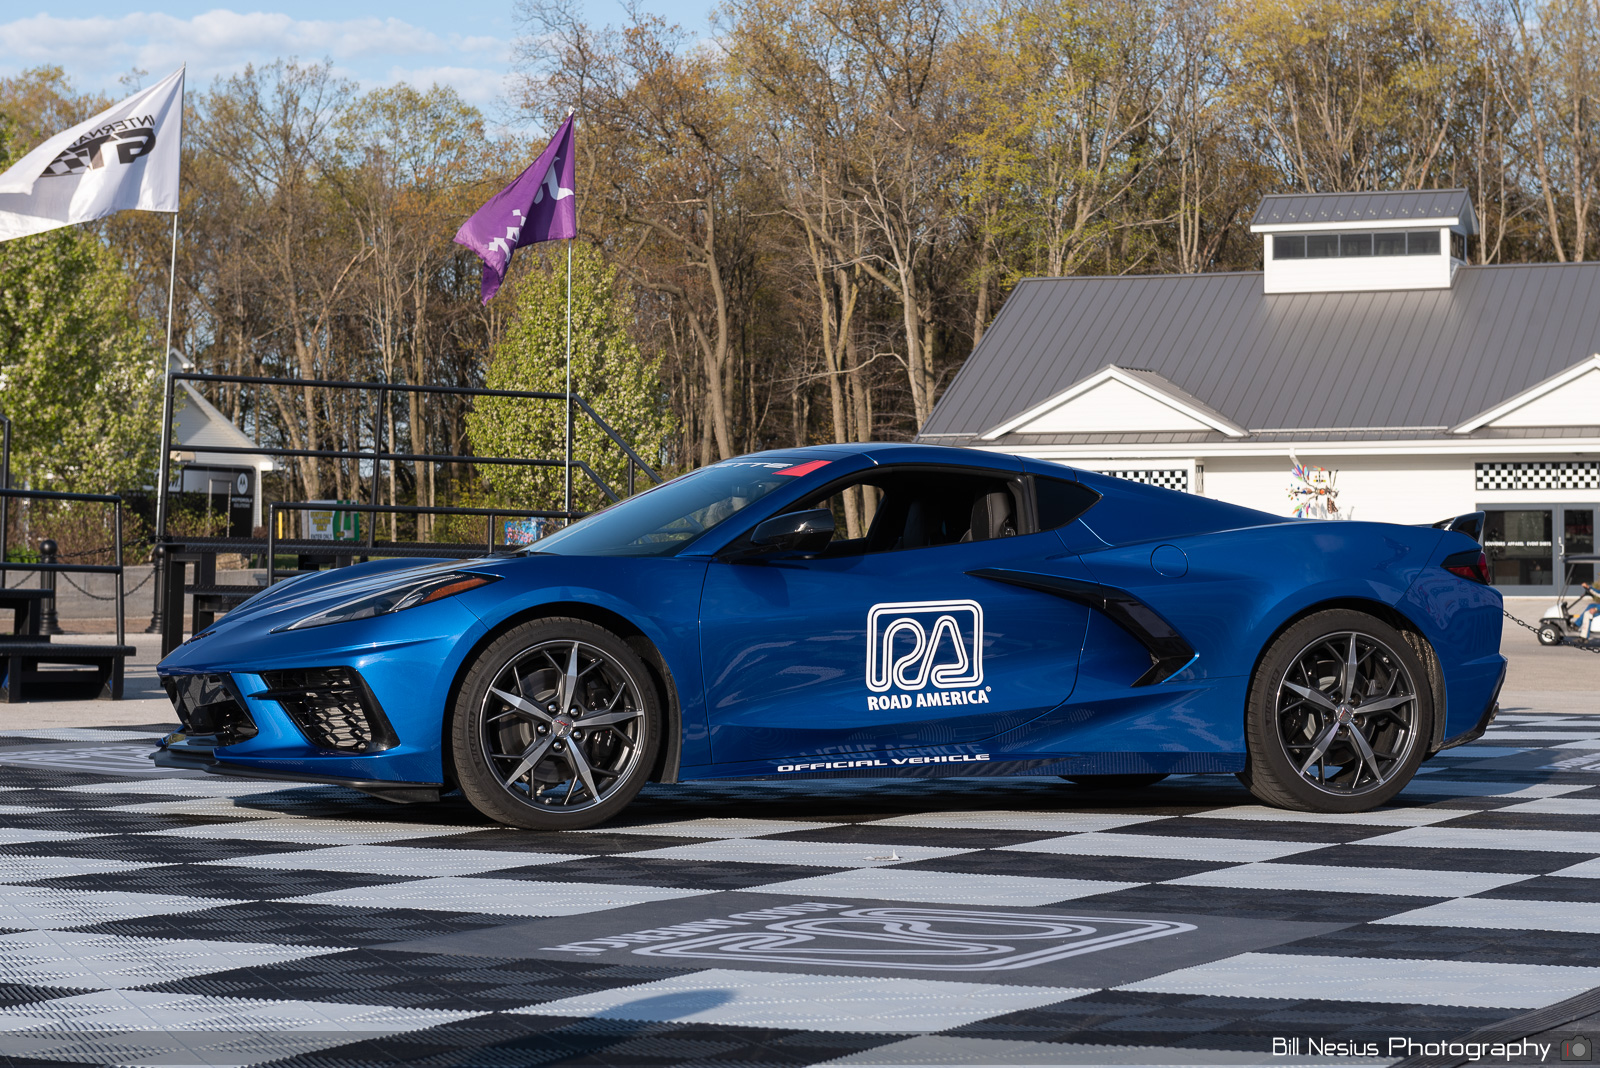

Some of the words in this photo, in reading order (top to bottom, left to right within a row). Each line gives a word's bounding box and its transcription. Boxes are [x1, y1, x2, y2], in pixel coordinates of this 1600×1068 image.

[867, 695, 913, 711] ROAD
[777, 759, 888, 773] OFFICIAL
[891, 753, 990, 766] VEHICLE
